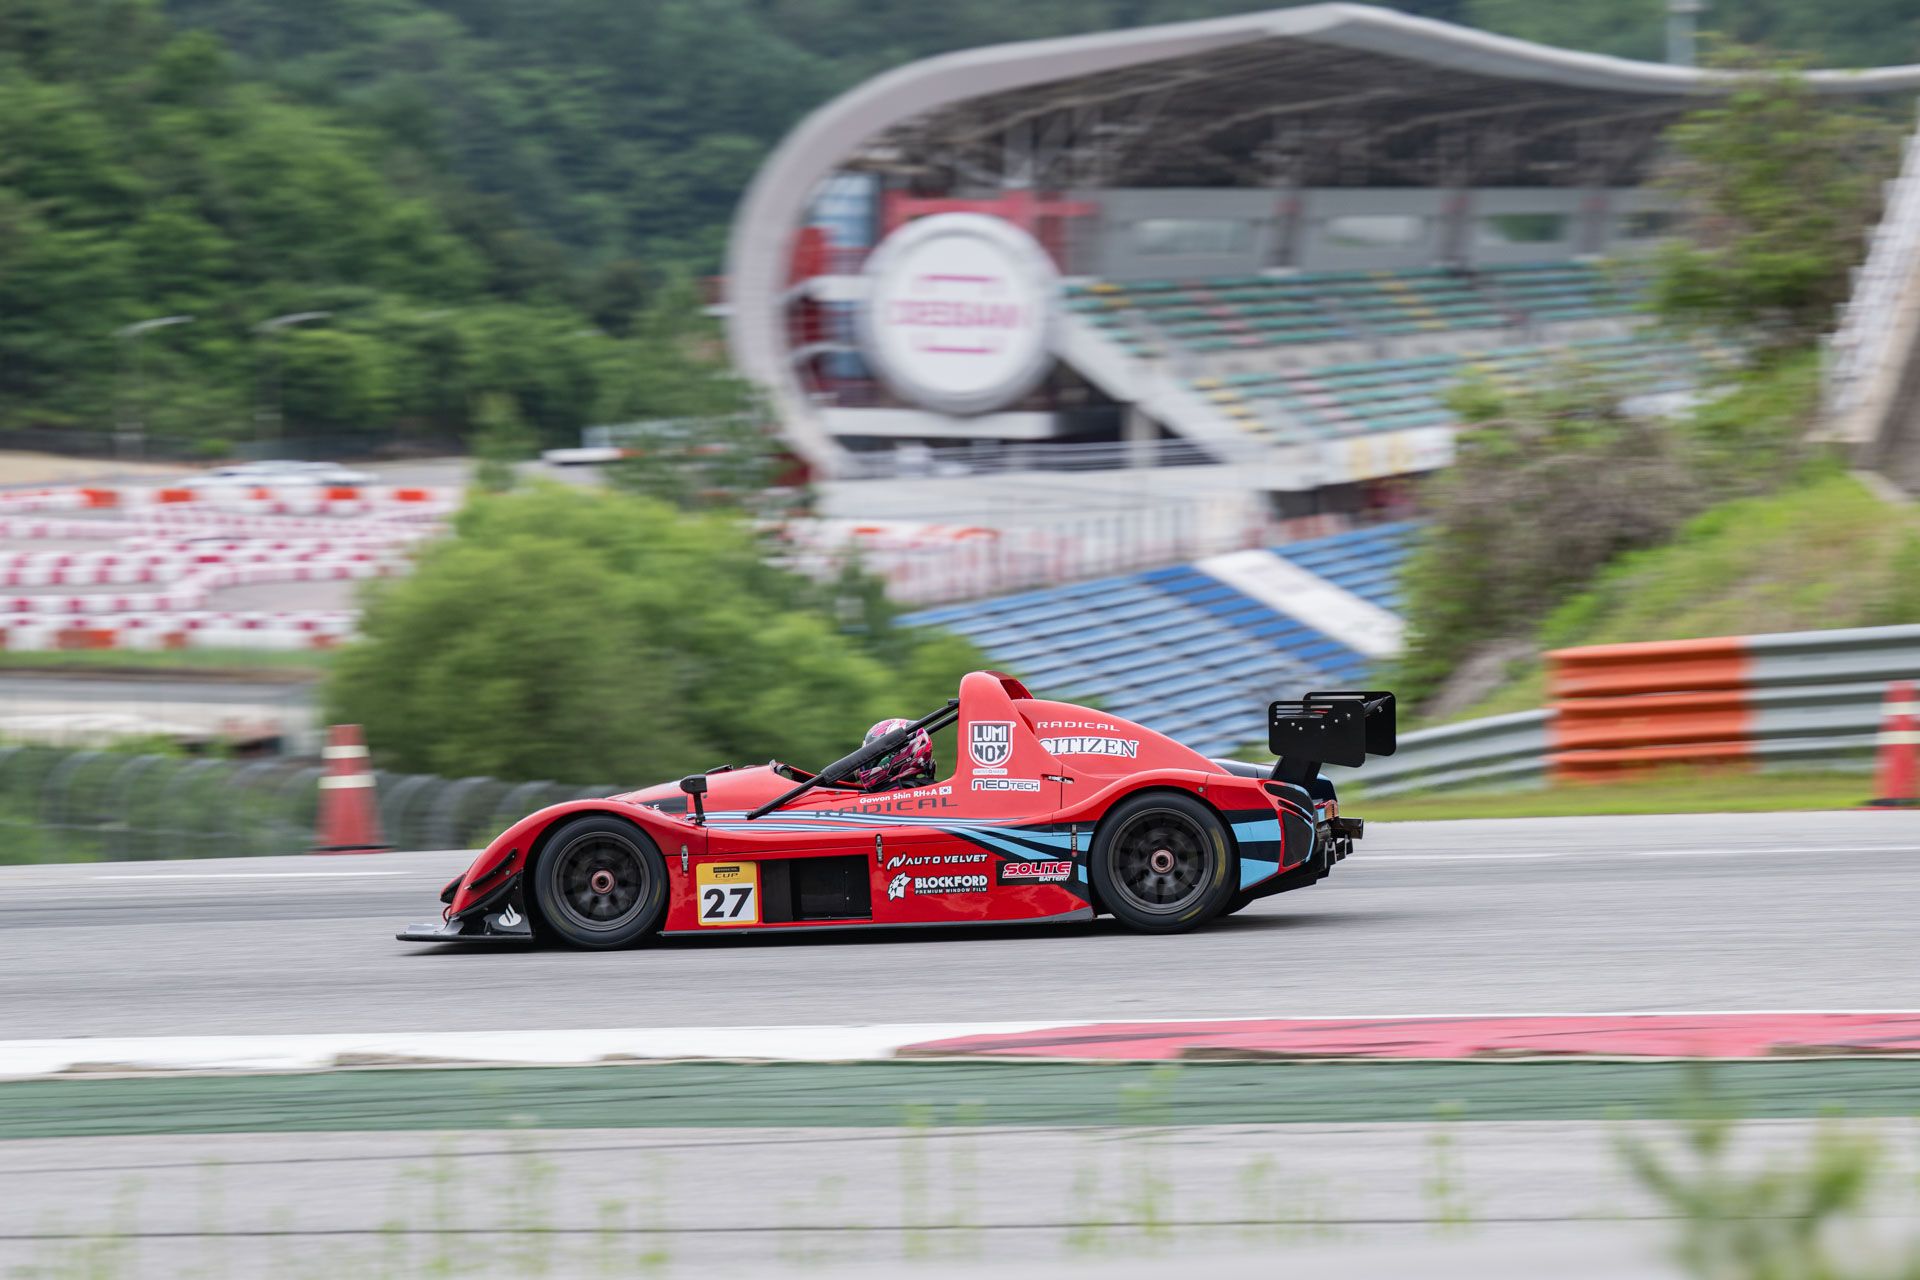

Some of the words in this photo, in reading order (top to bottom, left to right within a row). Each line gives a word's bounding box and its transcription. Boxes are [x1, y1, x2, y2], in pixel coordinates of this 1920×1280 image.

[973, 725, 1007, 742] LUMI
[1037, 721, 1121, 732] RADICAL
[974, 744, 1007, 762] NOX
[973, 779, 1039, 791] NEOTECH
[859, 796, 891, 805] Gawon
[893, 791, 911, 800] Shin
[913, 788, 938, 798] RH+A
[815, 797, 960, 819] RADICAL
[905, 856, 941, 866] AUTO
[943, 854, 988, 864] VELVET
[1003, 861, 1072, 876] SOLITE
[914, 874, 988, 889] BLOCKFORD
[703, 887, 753, 918] 27
